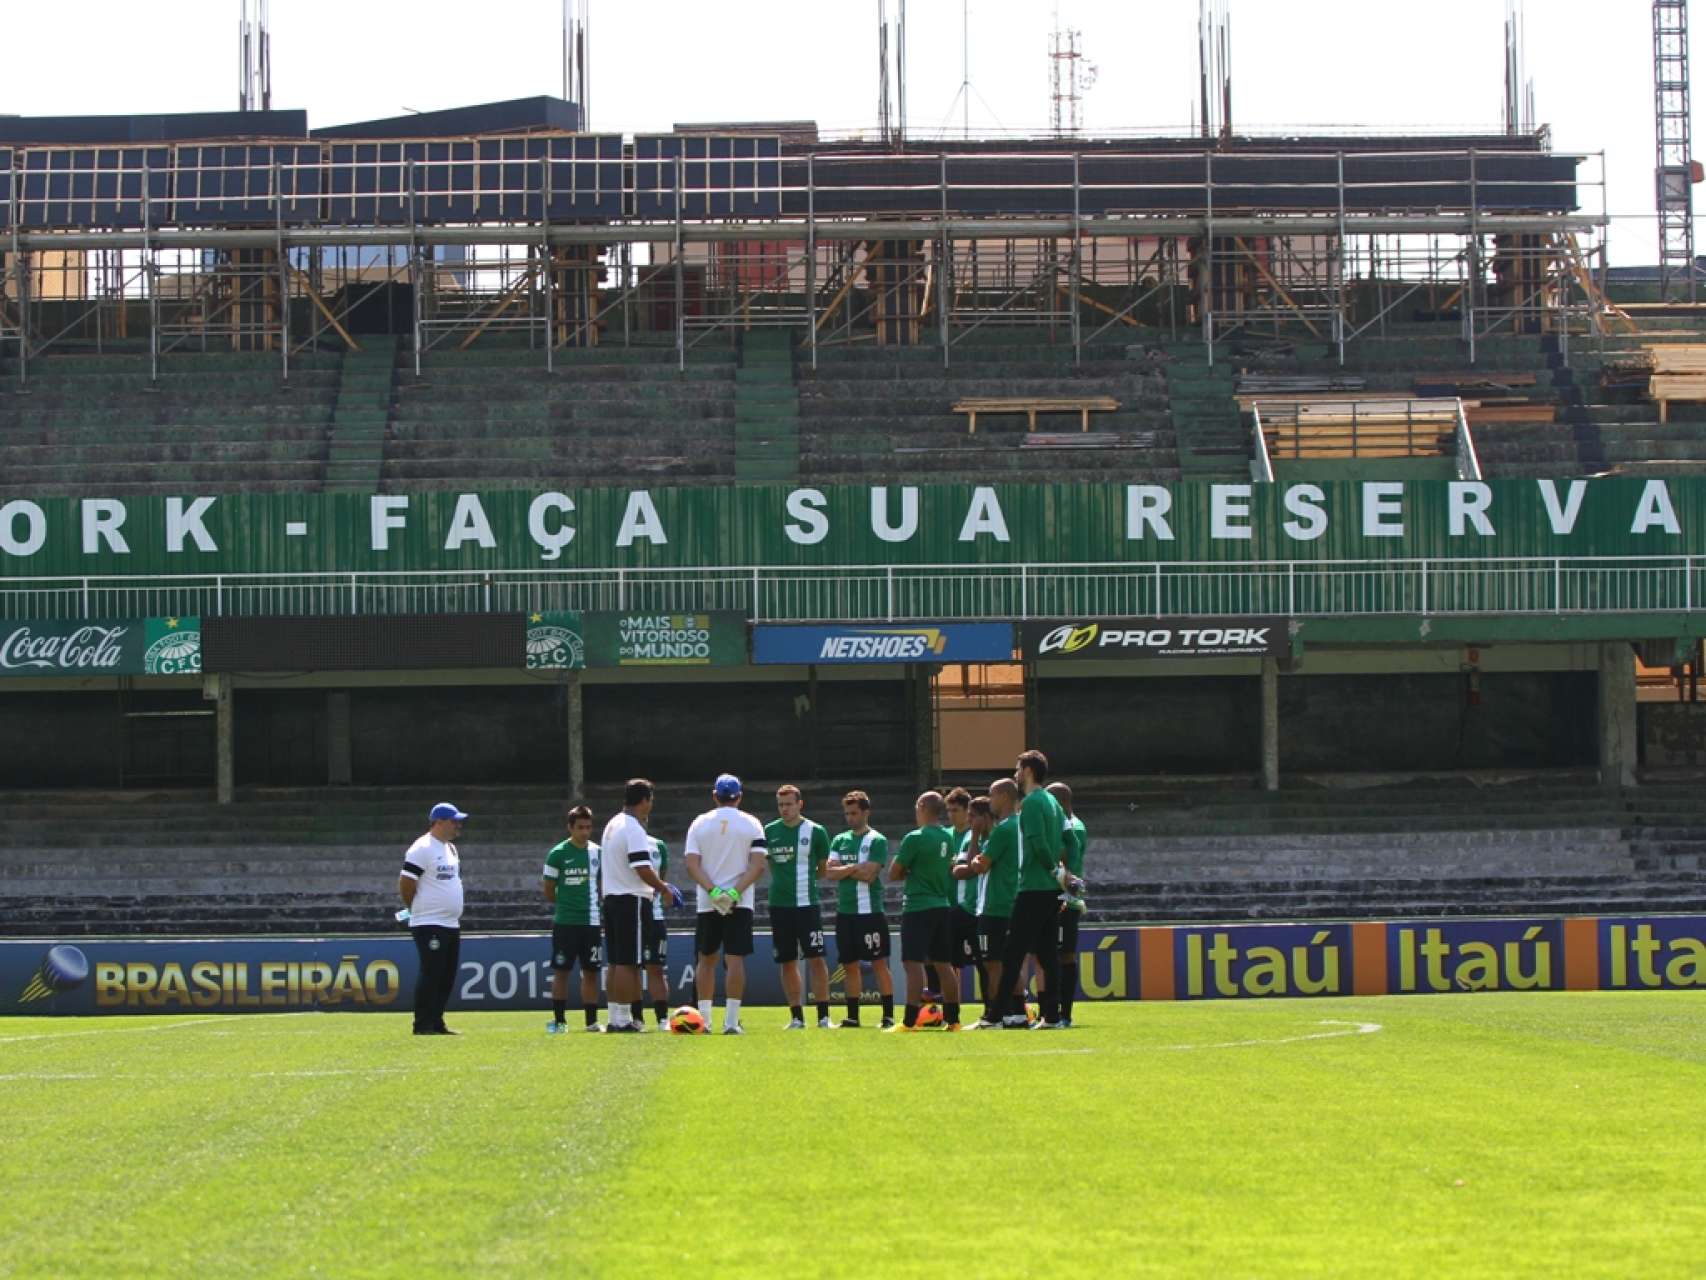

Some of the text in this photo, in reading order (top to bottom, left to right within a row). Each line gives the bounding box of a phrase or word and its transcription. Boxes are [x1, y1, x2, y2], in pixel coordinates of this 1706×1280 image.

[0, 496, 218, 556] ORK
[371, 490, 668, 561] FAÇA
[784, 486, 1010, 544] SUA
[1126, 479, 1682, 542] RESERVA
[628, 616, 671, 630] MAIS
[620, 629, 709, 643] VITORIOSO
[820, 635, 928, 659] NETSHOES
[1099, 627, 1271, 647] PRO TORK
[634, 643, 709, 658] MUNDO
[1186, 931, 1340, 996] Itaú
[1399, 926, 1552, 992] Itaú
[96, 955, 400, 1007] BRASILEIRÃO
